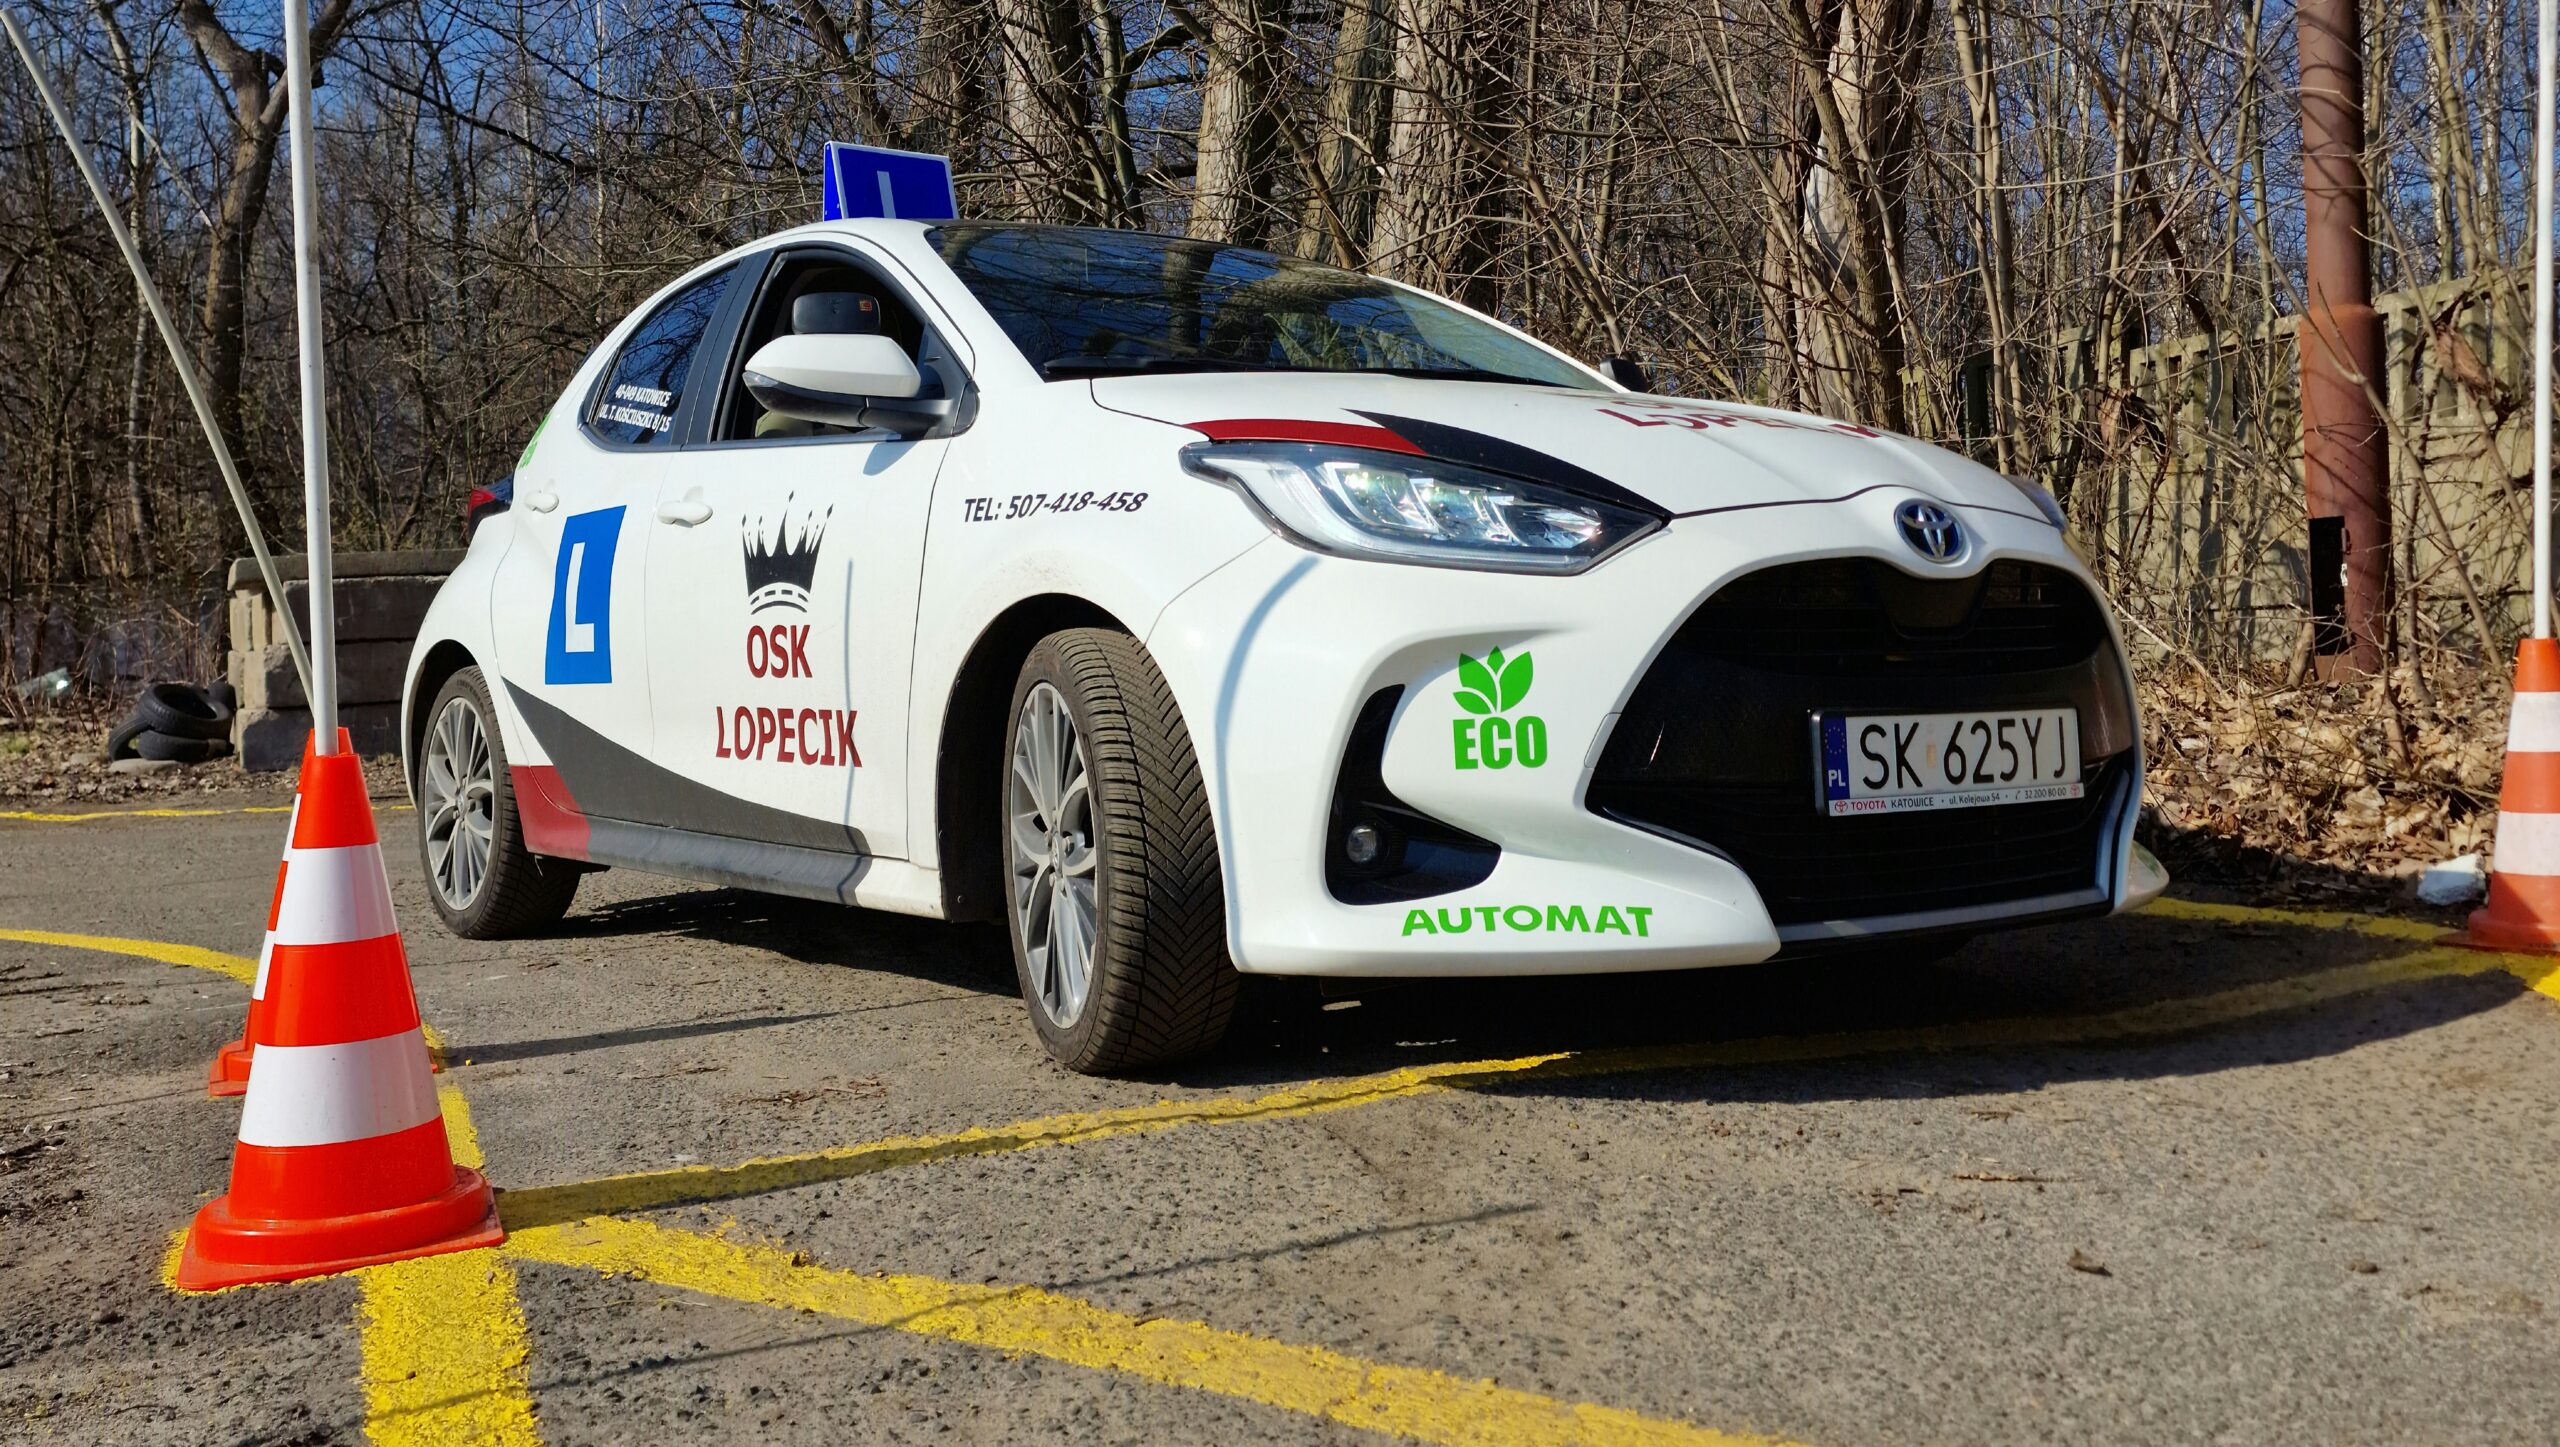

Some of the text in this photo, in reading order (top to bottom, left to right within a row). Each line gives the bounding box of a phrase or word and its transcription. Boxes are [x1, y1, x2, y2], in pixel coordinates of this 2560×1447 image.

[634, 387, 672, 407] KATOWICE
[652, 414, 672, 433] 8/15
[964, 491, 1149, 522] TEL: 507-418-458
[565, 542, 595, 653] L
[746, 624, 813, 679] OSK
[715, 705, 863, 768] LOPECIK
[1452, 715, 1548, 770] ECO
[1828, 716, 2066, 790] PL SK 625YJ
[1851, 800, 1887, 811] TOYOTA
[1890, 797, 1934, 809] KATOWICE
[1959, 794, 1990, 805] Kolejowa
[1991, 793, 2000, 802] 54
[2024, 790, 2033, 799] 32
[2033, 789, 2047, 799] 200
[1401, 905, 1654, 938] AUTOMAT
